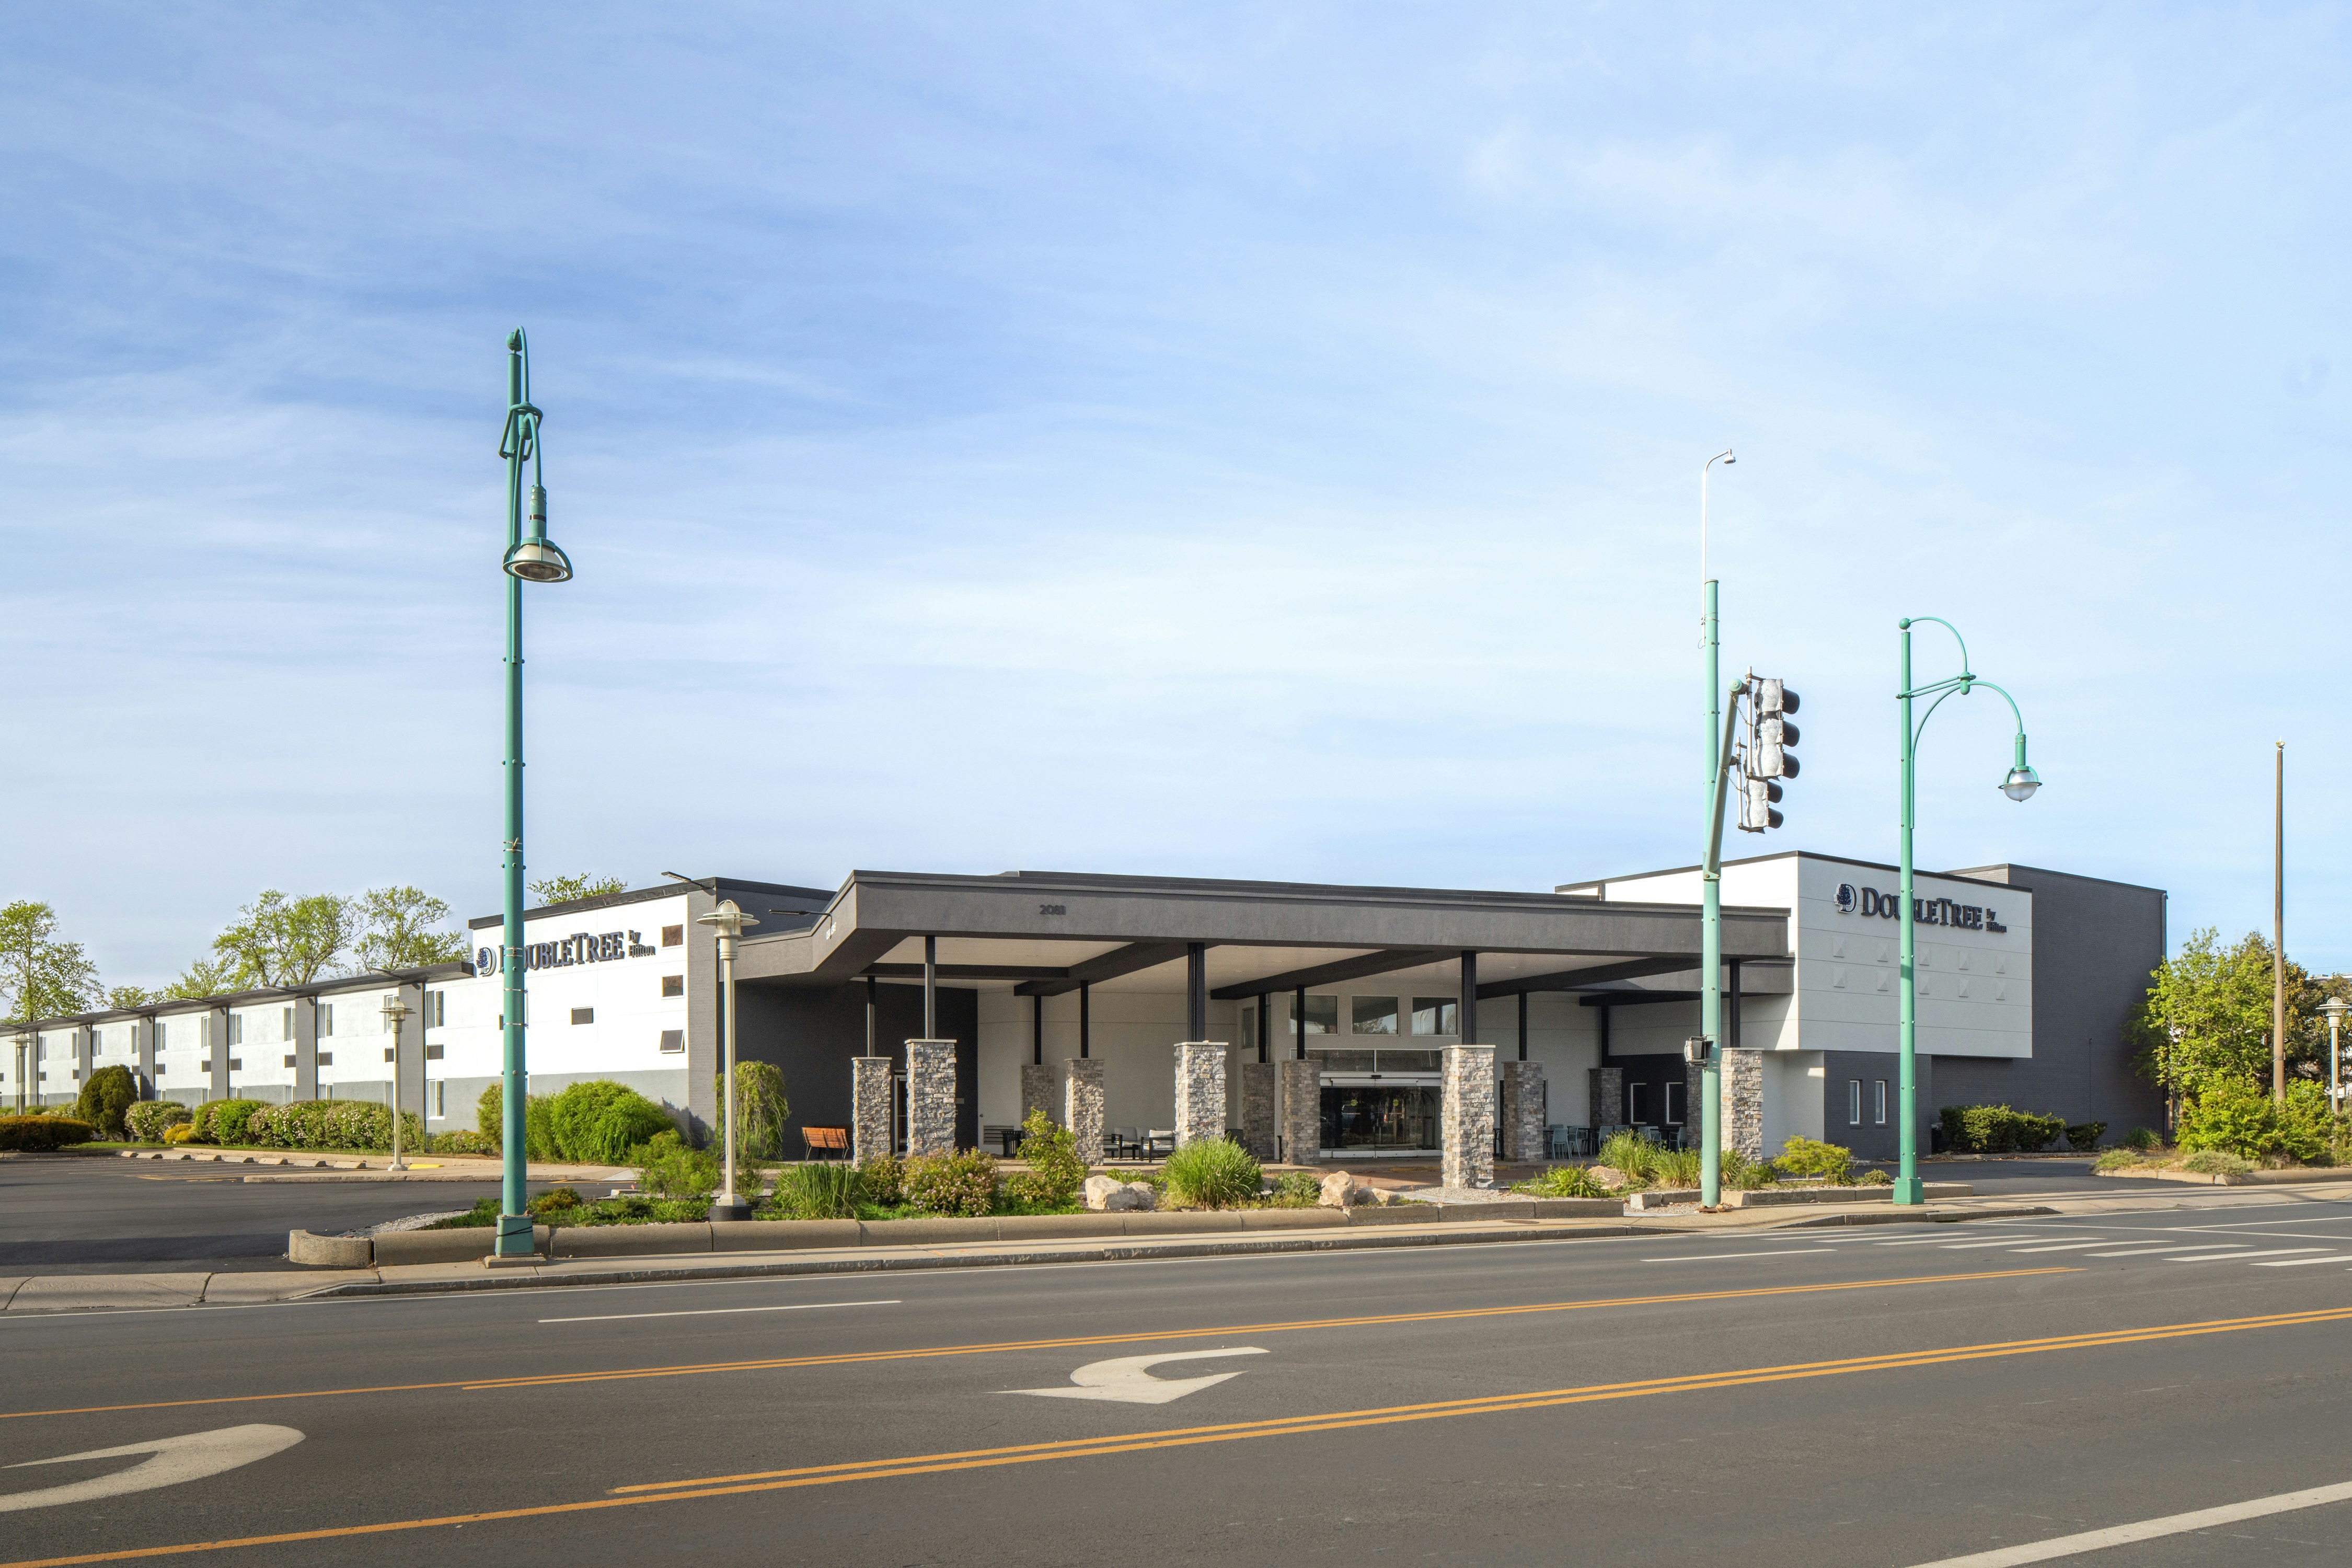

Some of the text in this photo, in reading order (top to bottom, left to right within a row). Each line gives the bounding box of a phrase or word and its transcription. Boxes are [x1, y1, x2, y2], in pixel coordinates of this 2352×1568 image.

[1986, 908, 1996, 921] by
[1986, 921, 2007, 933] Hilton
[628, 930, 641, 943] by
[628, 944, 655, 958] Hilton
